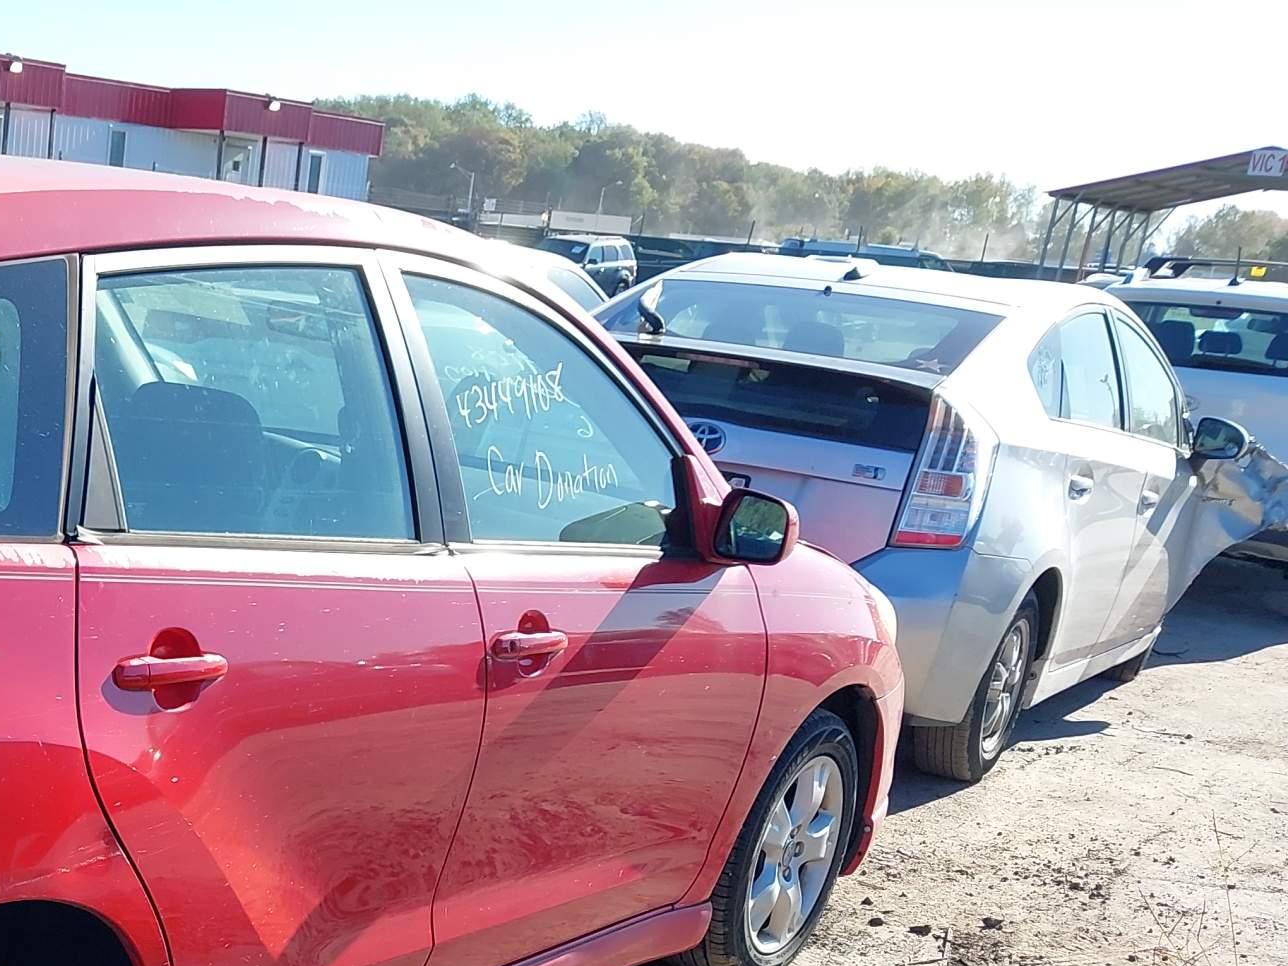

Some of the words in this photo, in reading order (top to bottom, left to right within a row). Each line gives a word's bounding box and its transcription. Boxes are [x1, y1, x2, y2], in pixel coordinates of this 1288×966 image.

[1252, 153, 1275, 173] VIC
[456, 361, 563, 428] 43449108
[487, 445, 524, 496] Car
[535, 450, 618, 509] Donation
